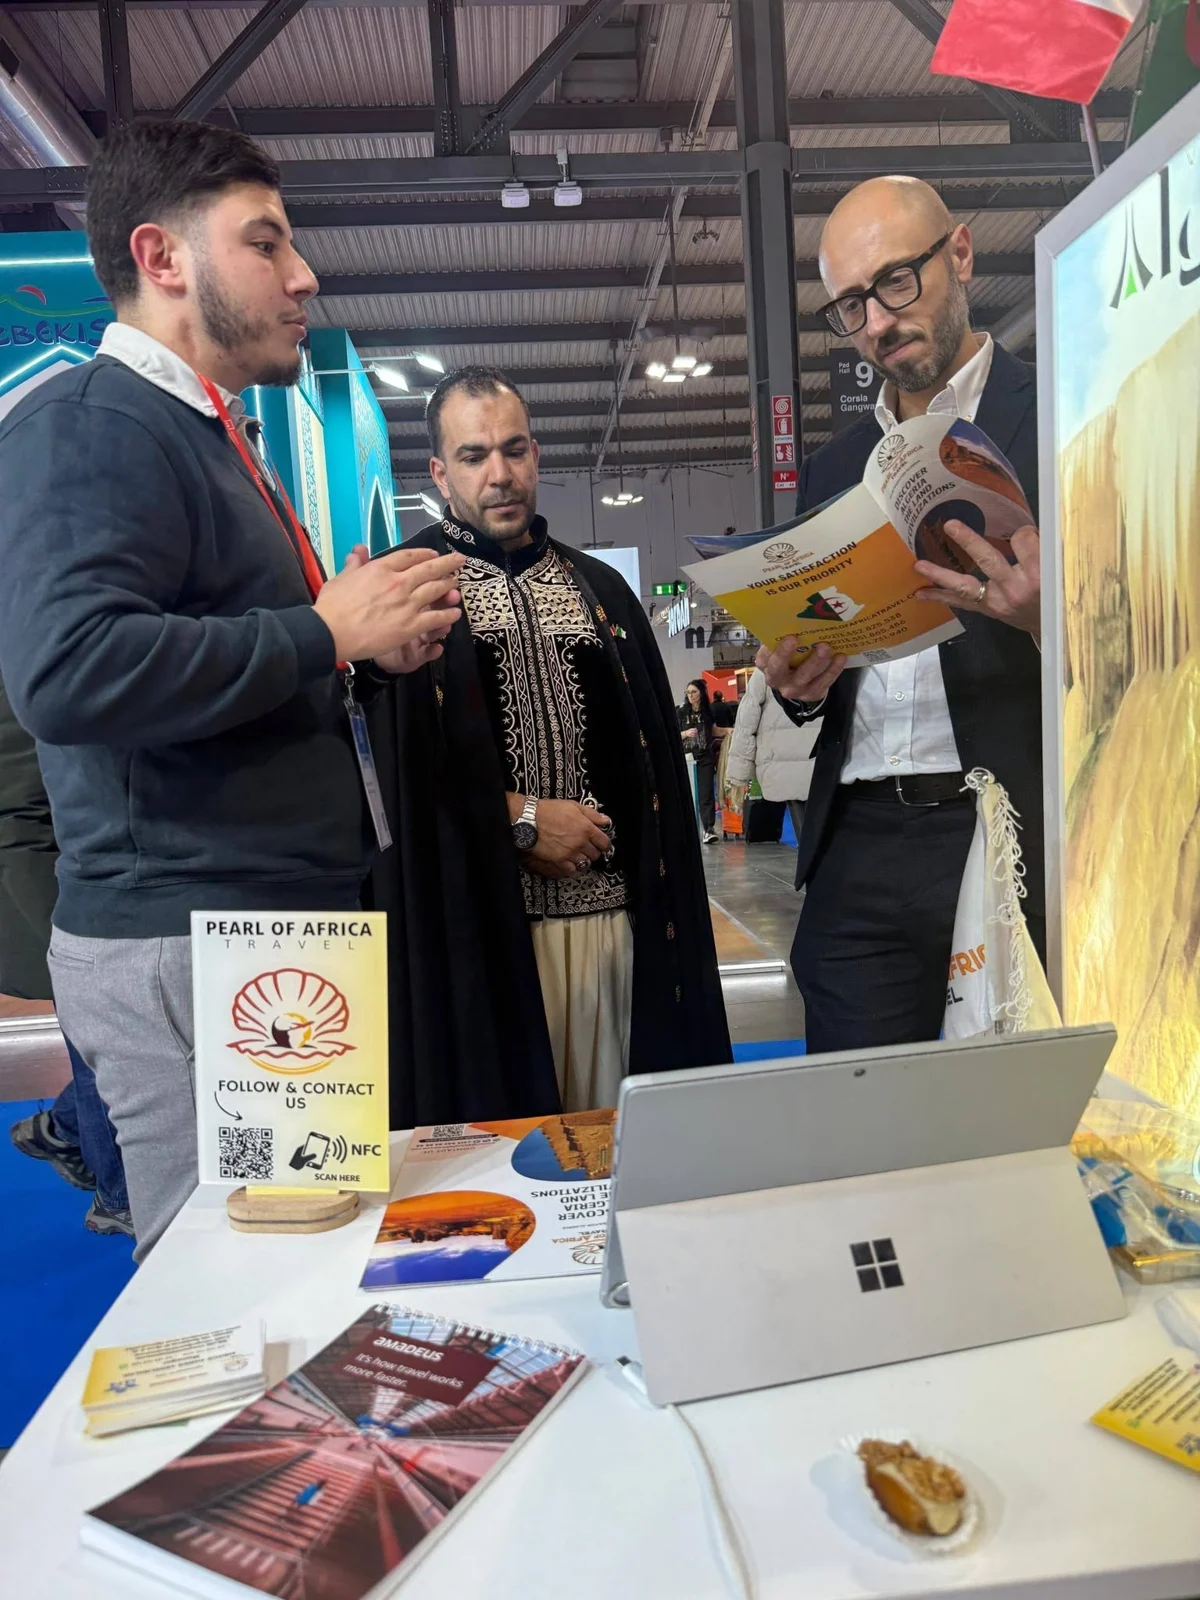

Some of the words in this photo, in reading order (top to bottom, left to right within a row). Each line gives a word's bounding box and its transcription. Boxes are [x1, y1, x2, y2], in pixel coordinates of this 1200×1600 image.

[855, 361, 874, 388] 9
[840, 394, 868, 403] Corsia
[840, 403, 876, 413] Gangwa
[895, 467, 928, 511] DISCOVER
[900, 478, 927, 515] ALGERIA
[904, 506, 913, 525] THE
[912, 484, 932, 507] LAND
[907, 481, 956, 537] CIVILIZATIONS
[747, 577, 778, 591] YOUR
[778, 541, 857, 582] SATISFACTION
[765, 588, 777, 597] IS
[778, 581, 802, 593] OUR
[803, 558, 853, 585] PRIORITY
[206, 921, 264, 936] PEARL
[271, 921, 295, 936] OF
[303, 922, 373, 937] AFRICA
[225, 939, 355, 950] TRAVEL
[218, 1080, 280, 1093] FOLLOW
[286, 1082, 297, 1094] &
[303, 1082, 375, 1096] CONTACT
[286, 1097, 307, 1109] US
[351, 1144, 382, 1157] NFC
[314, 1173, 338, 1182] SCAN
[339, 1174, 361, 1182] HERE
[530, 1183, 611, 1198] ILIZATIONS
[560, 1193, 596, 1204] LAND
[564, 1200, 608, 1212] GERIA
[558, 1209, 610, 1221] COVER
[552, 1235, 591, 1244] AFRICA
[343, 1364, 374, 1377] more
[373, 1371, 408, 1387] faster.
[355, 1353, 373, 1364] It's
[372, 1357, 396, 1371] how
[397, 1364, 431, 1379] travel
[428, 1373, 464, 1389] works
